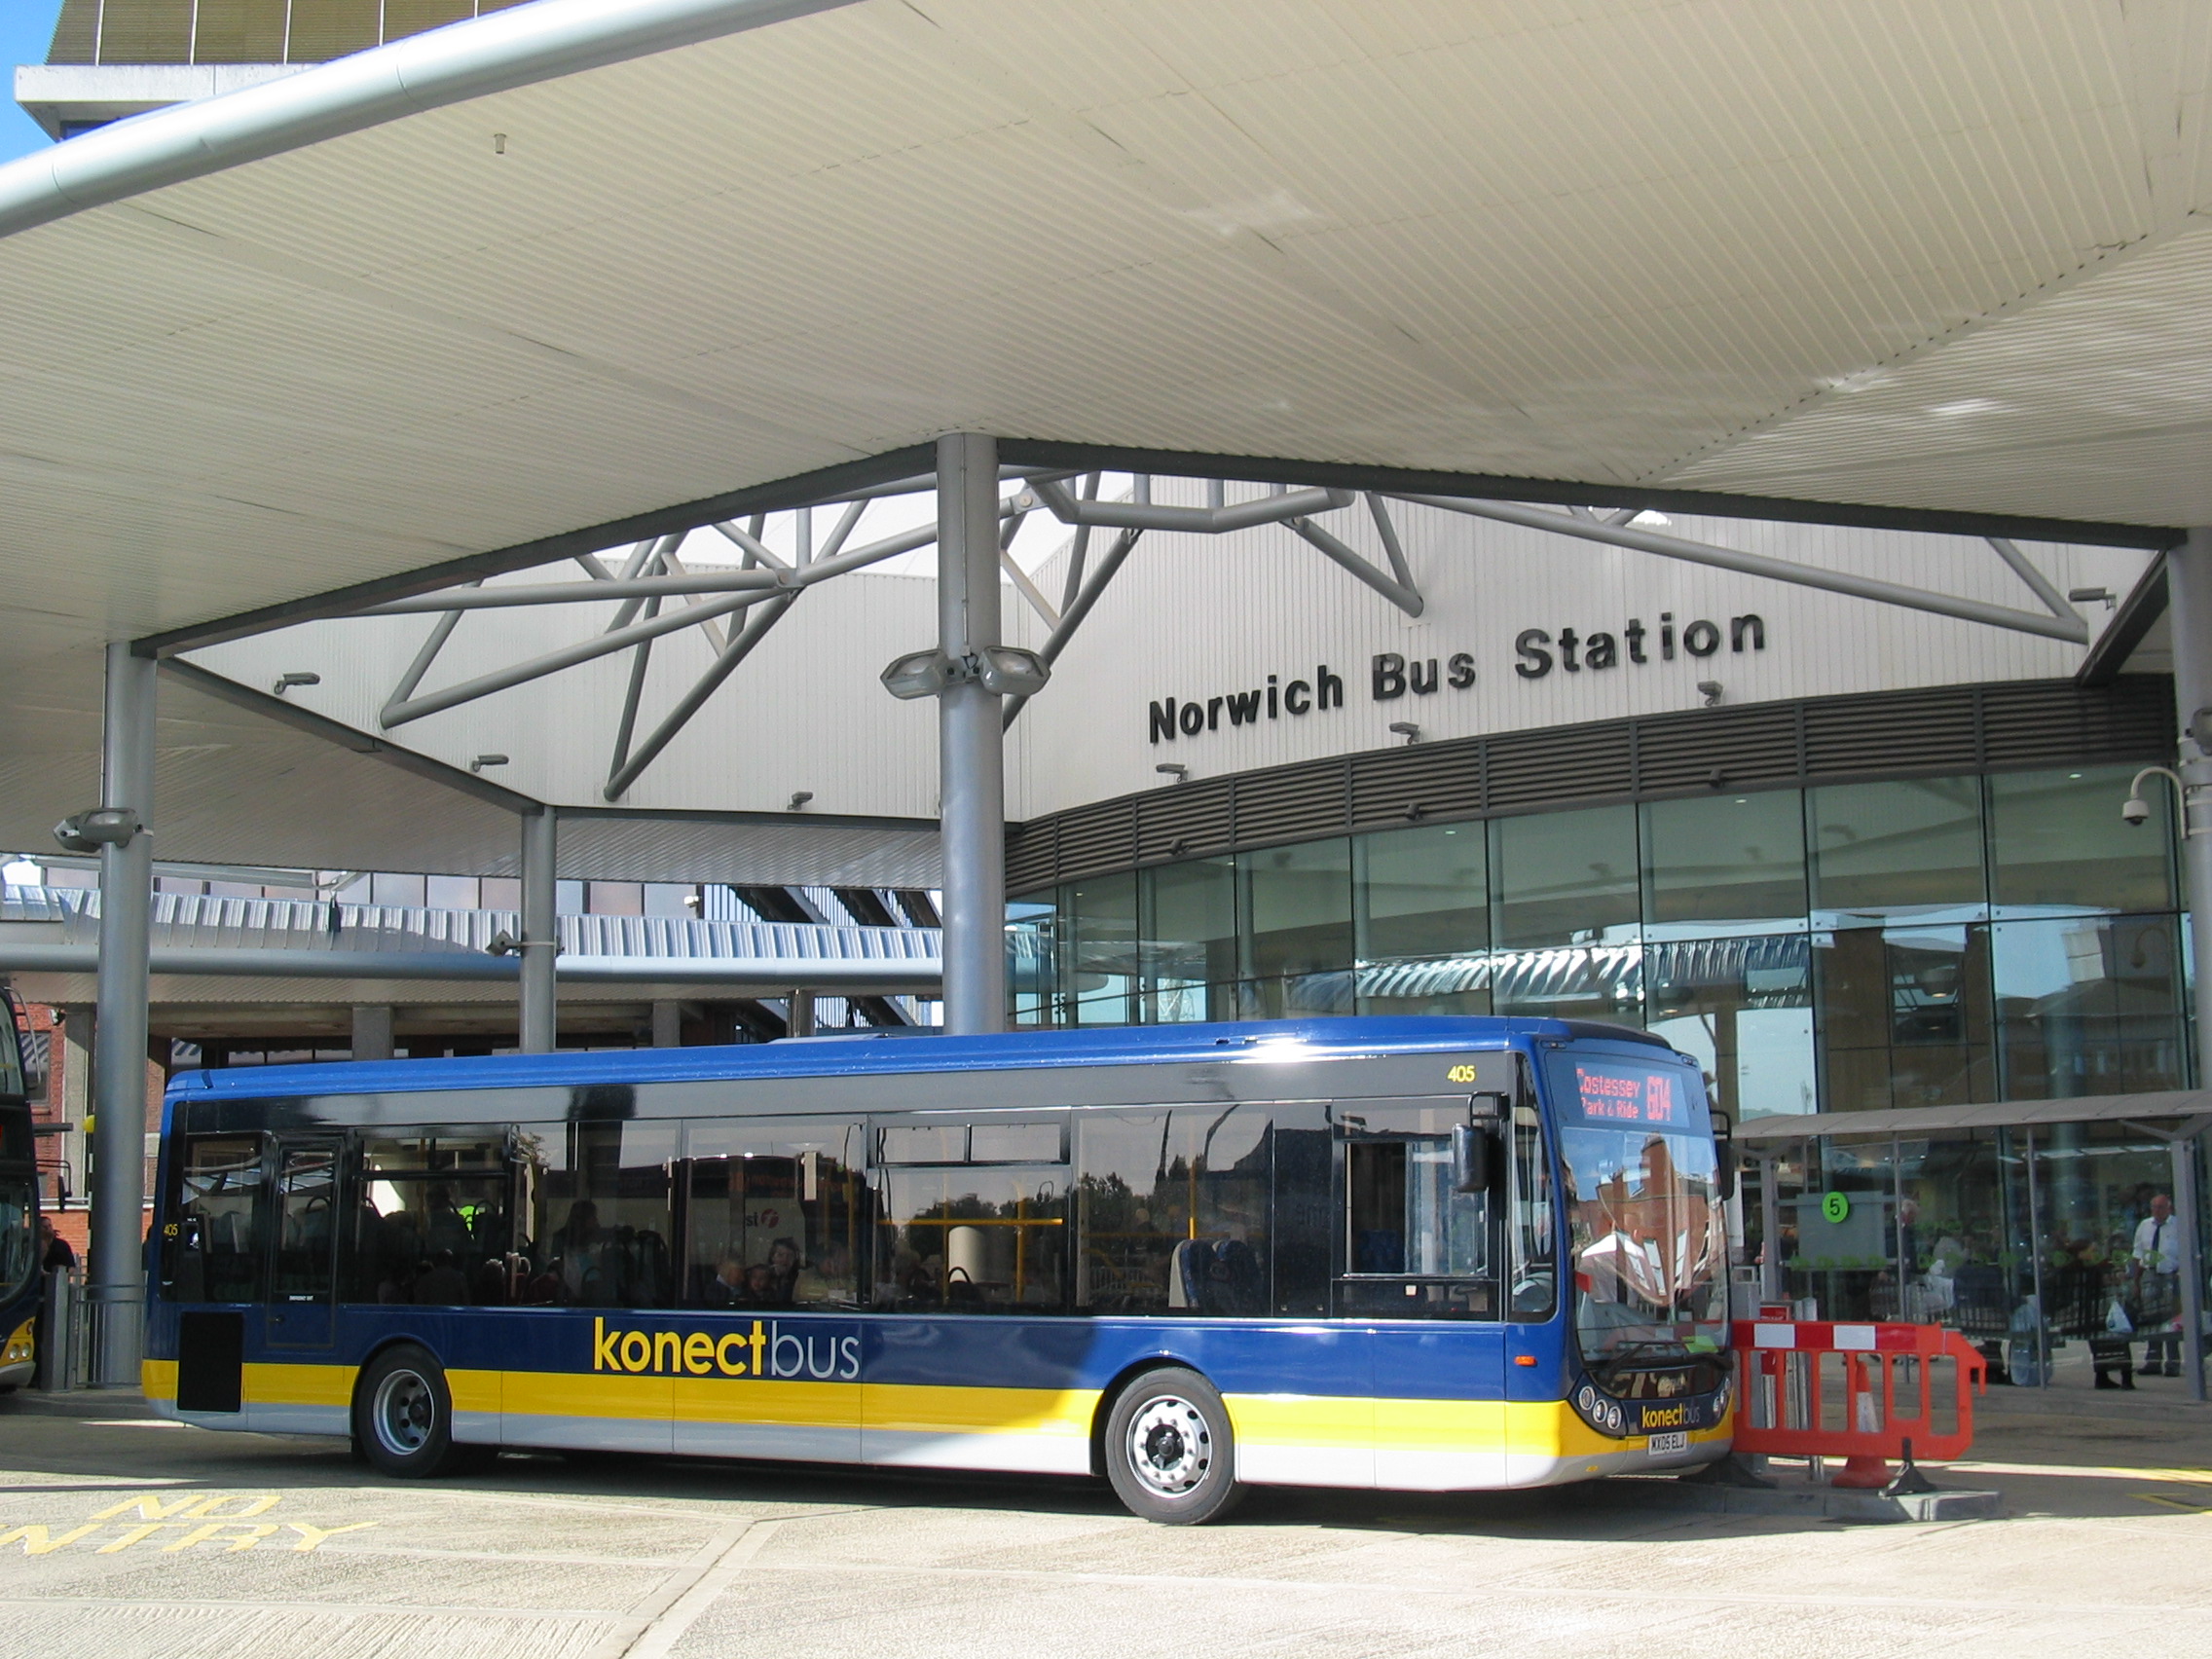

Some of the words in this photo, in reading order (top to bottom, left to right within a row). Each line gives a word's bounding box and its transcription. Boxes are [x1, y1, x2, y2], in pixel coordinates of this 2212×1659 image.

[1150, 665, 1343, 743] Norwich
[1372, 651, 1475, 700] Bus
[1514, 612, 1765, 679] Station
[1448, 1065, 1476, 1083] 405
[1616, 1099, 1640, 1119] Ride
[1829, 1198, 1841, 1216] 5
[164, 1223, 178, 1236] 405
[593, 1316, 860, 1380] konectbus
[1641, 1402, 1700, 1428] konectbus
[89, 1494, 282, 1520] NO
[0, 1521, 382, 1555] NTRY
